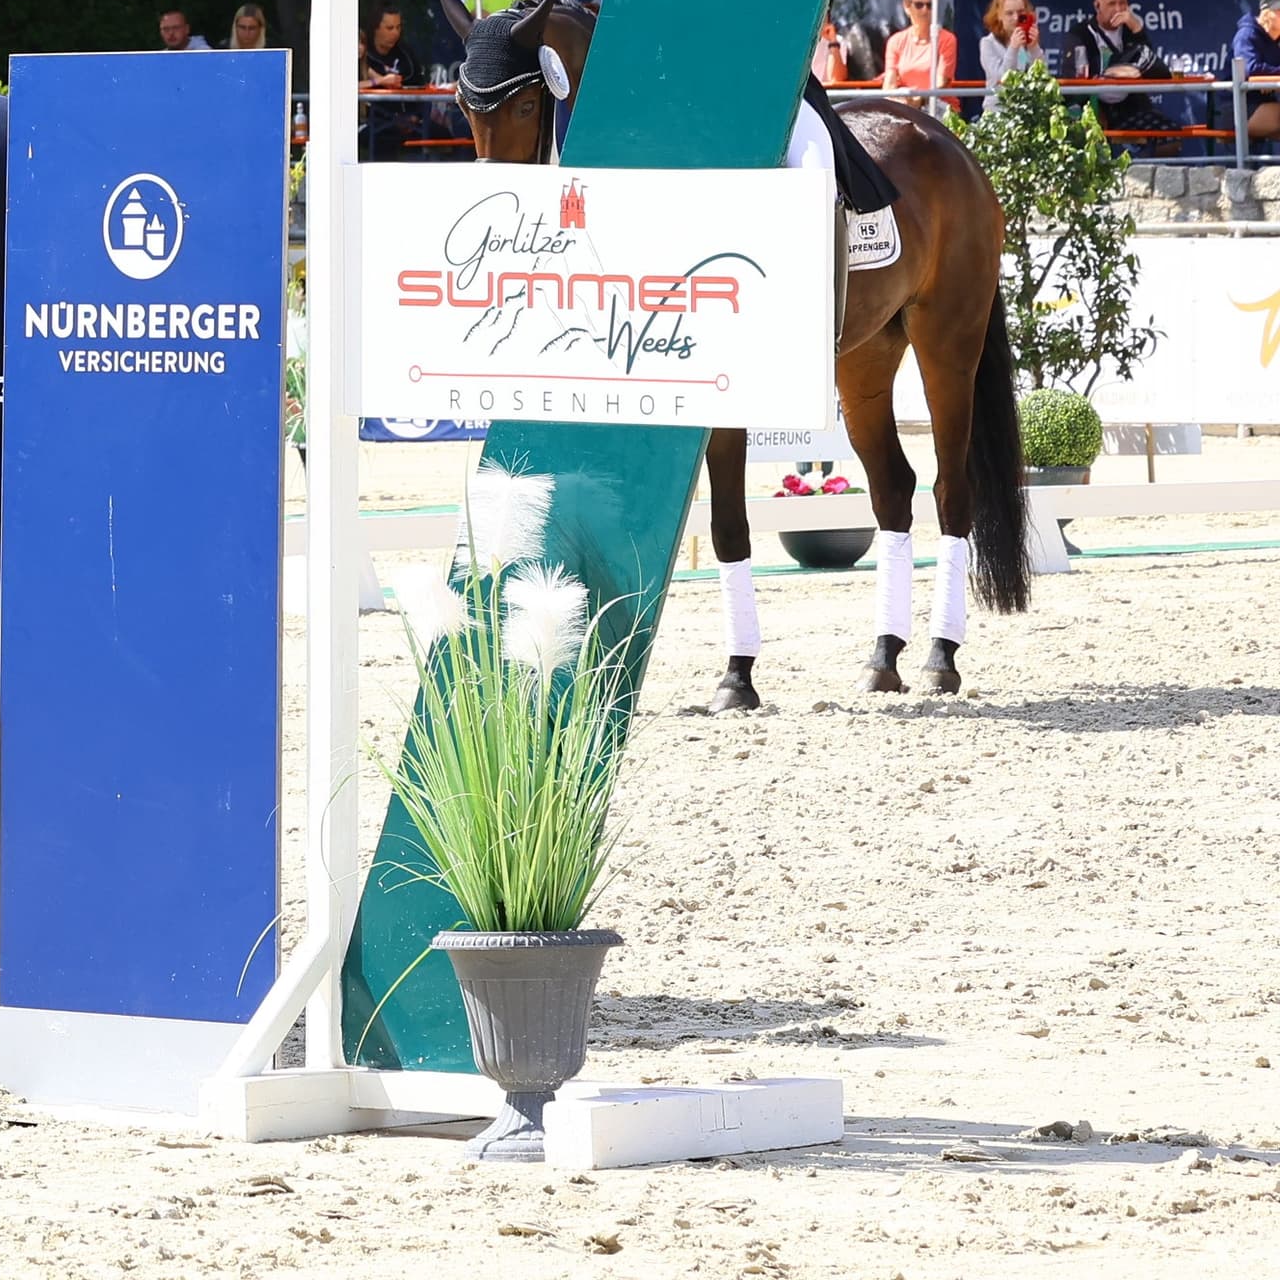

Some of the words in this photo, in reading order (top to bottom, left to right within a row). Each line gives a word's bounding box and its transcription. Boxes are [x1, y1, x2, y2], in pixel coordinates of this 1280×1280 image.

[860, 225, 876, 236] HS
[397, 270, 740, 313] SUMMER
[25, 301, 261, 340] NÜRNBERGER
[602, 294, 697, 375] Weeks
[58, 350, 226, 373] VERSICHERUNG
[450, 389, 686, 416] ROSENHOF
